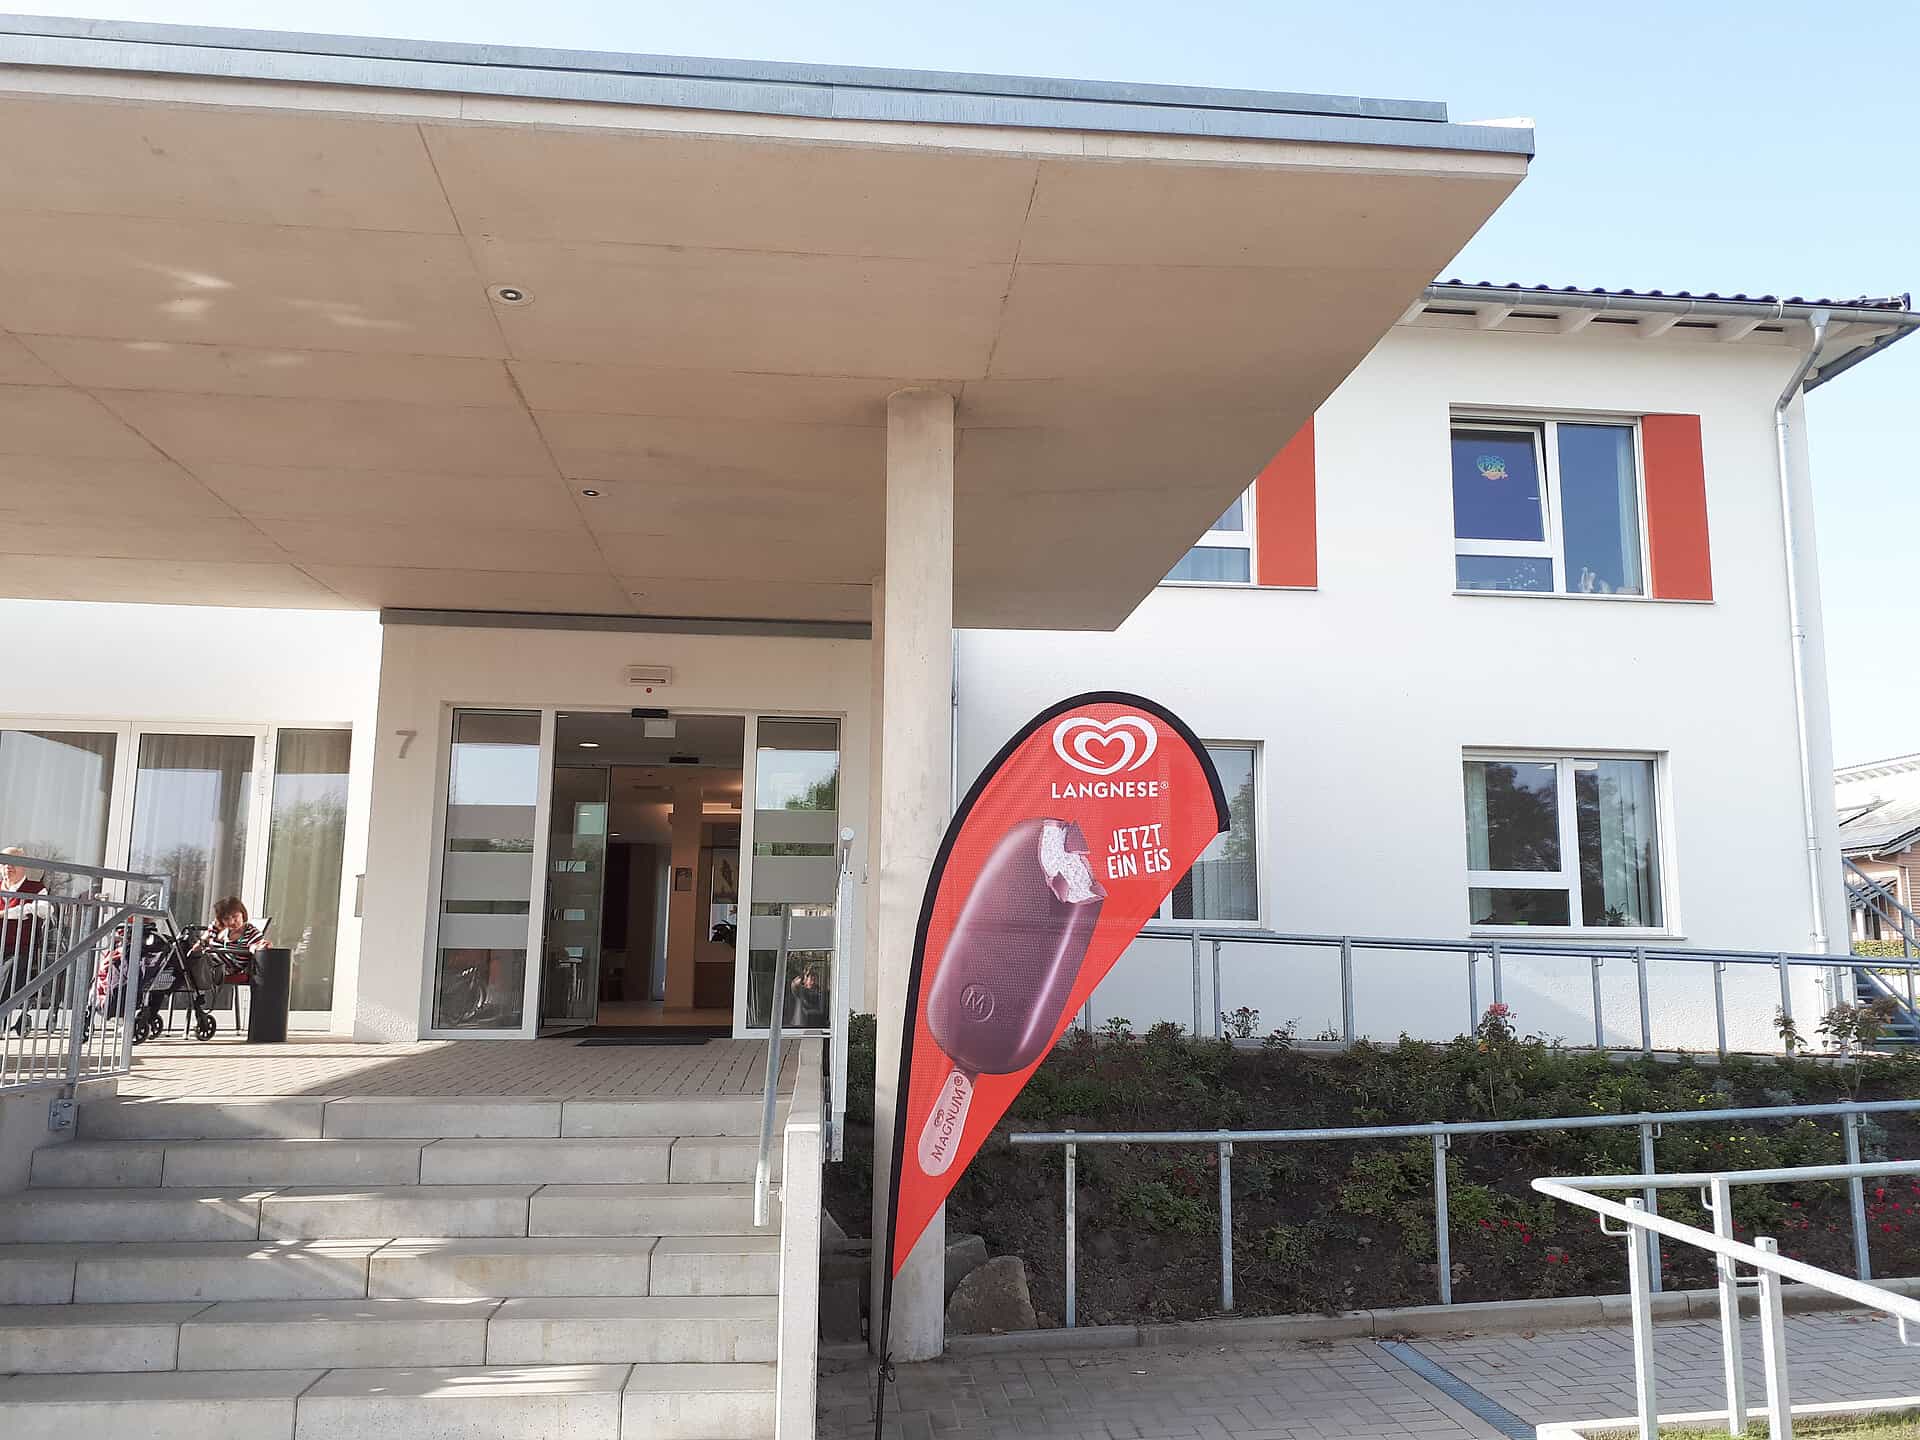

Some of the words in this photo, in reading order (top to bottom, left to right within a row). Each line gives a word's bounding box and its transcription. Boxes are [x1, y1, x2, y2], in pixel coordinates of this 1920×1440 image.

[395, 730, 417, 759] 7
[1108, 823, 1162, 853] JETZT
[964, 988, 985, 1014] M
